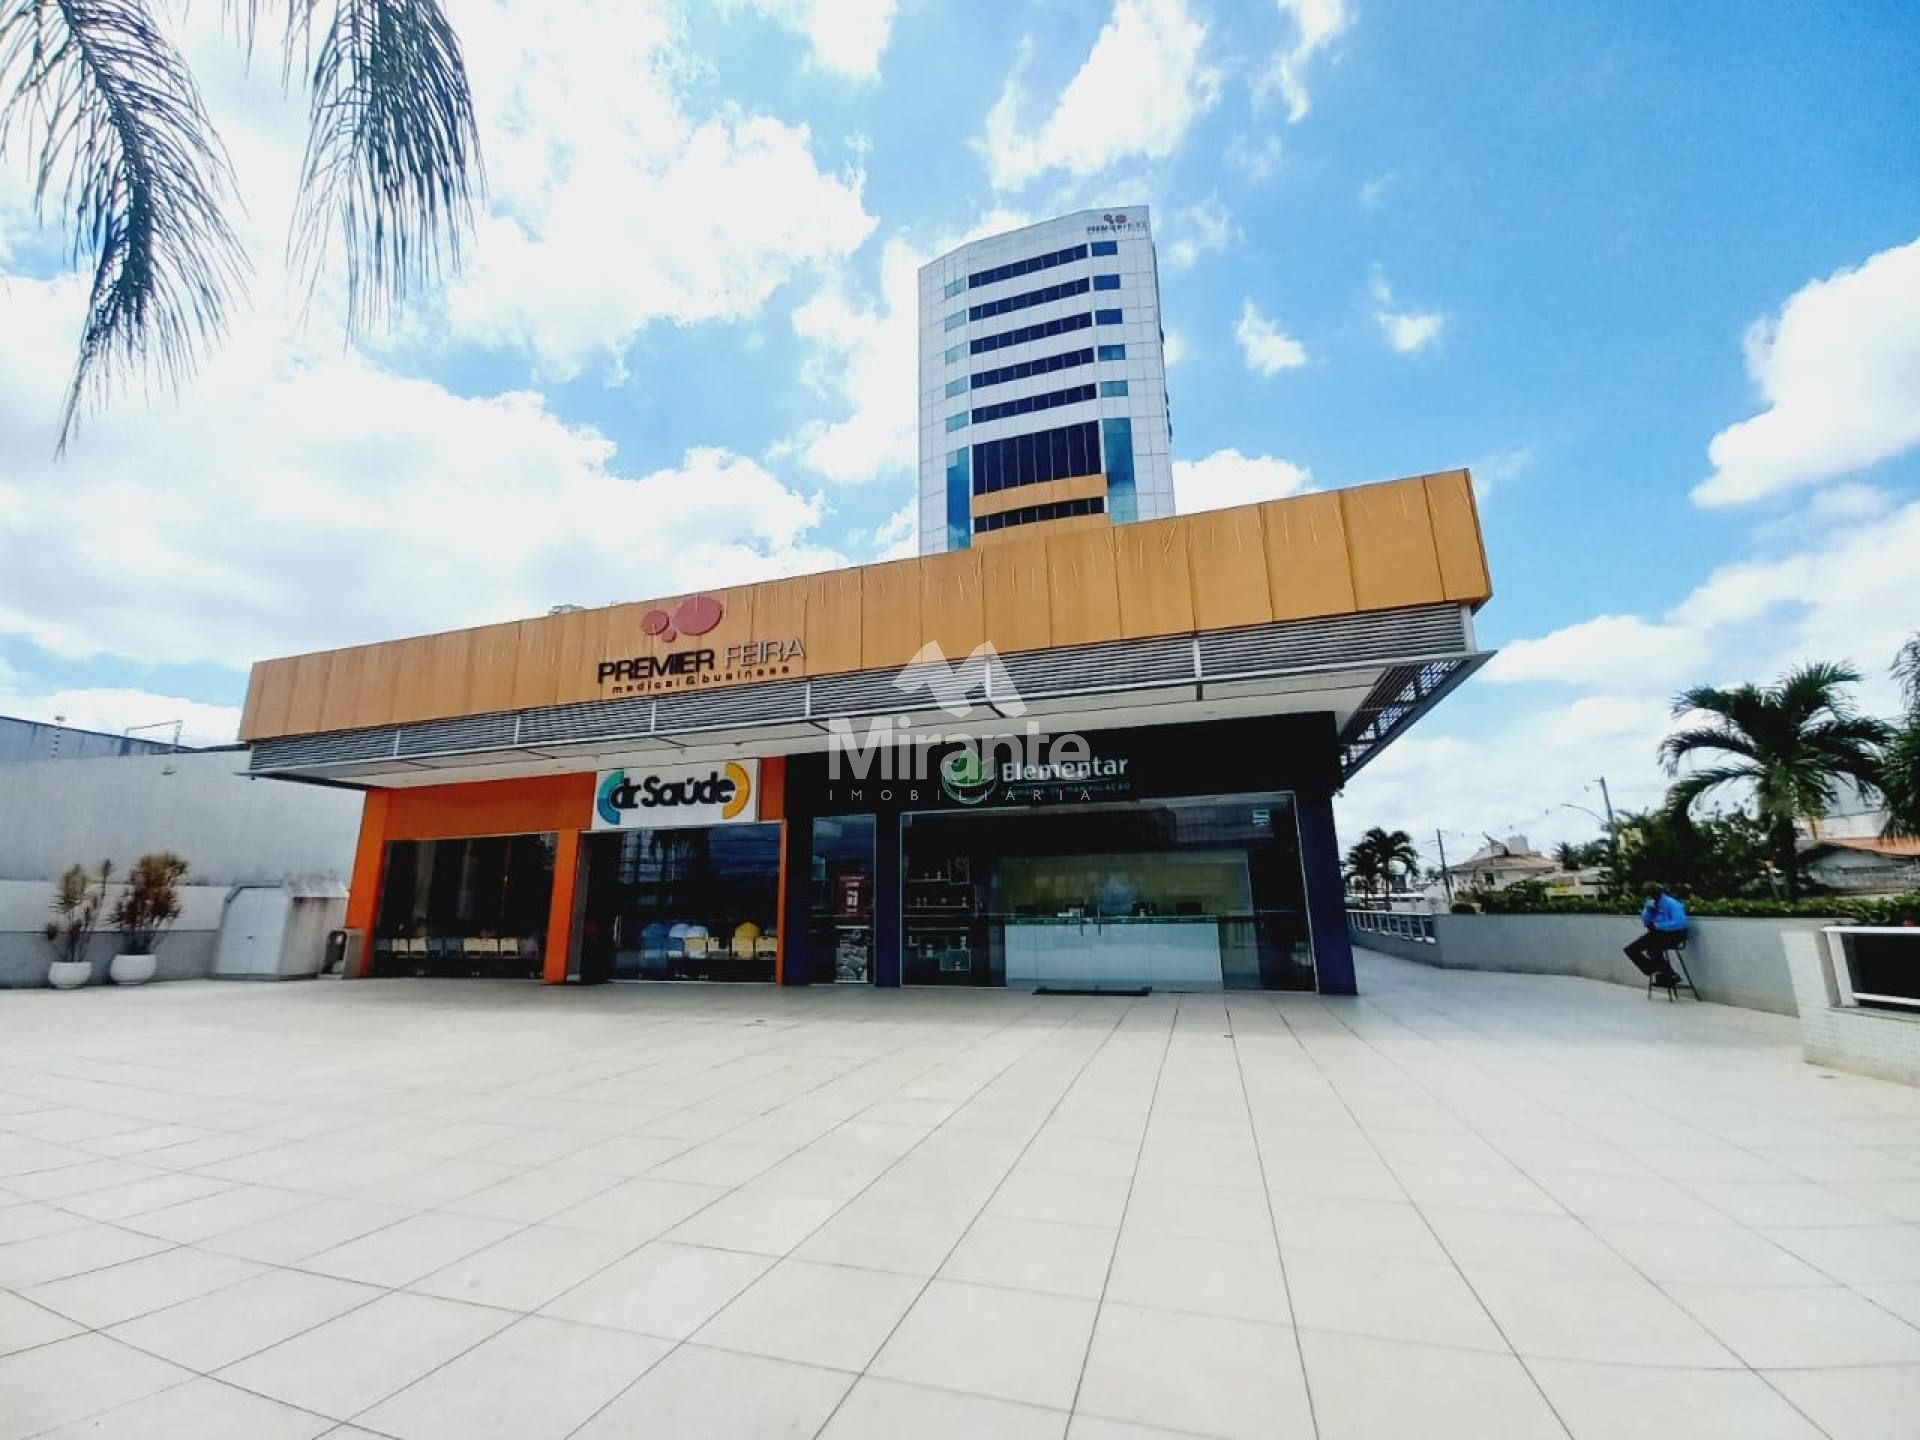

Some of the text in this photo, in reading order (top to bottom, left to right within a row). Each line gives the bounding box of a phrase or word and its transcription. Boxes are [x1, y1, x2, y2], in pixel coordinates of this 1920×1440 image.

[597, 637, 805, 684] PREMIER FEIRA
[1002, 756, 1129, 782] Elementar
[641, 770, 736, 808] Saúde
